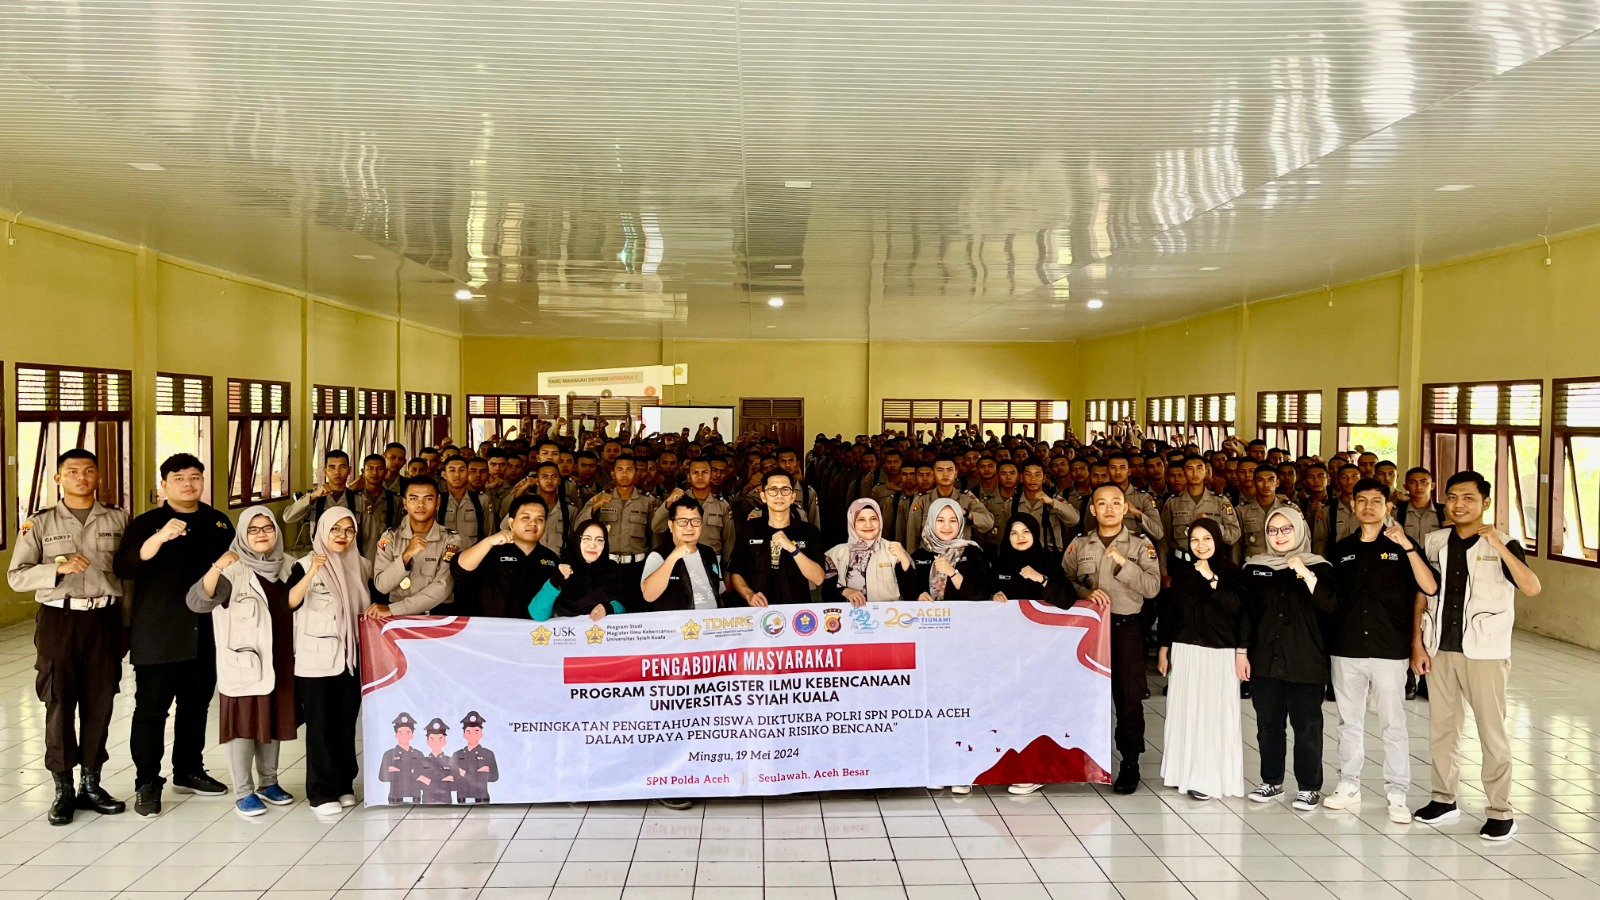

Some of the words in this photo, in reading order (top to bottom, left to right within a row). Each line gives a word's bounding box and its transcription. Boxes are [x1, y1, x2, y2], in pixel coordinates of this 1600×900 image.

[917, 608, 951, 617] ACEH
[703, 616, 753, 630] TDMRC
[553, 627, 576, 637] USK
[642, 653, 737, 677] PENGABDIAN
[744, 648, 843, 671] MASYARAKAT
[570, 686, 645, 699] PROGRAM
[650, 684, 689, 697] STUDI
[694, 680, 765, 694] MAGISTER
[769, 678, 801, 691] ILMU
[806, 675, 910, 689] KEBENCANAAN
[650, 694, 742, 710] UNIVERSITAS
[747, 693, 788, 705] SYIAH
[792, 691, 840, 704] KUALA
[612, 717, 710, 731] PENGETAHUAN
[714, 716, 754, 726] SISWA
[758, 712, 821, 725] DIKTUKBA
[826, 711, 862, 722] POLRI
[865, 710, 888, 720] SPN
[891, 709, 933, 719] POLDA
[937, 708, 970, 718] ACEH
[585, 735, 634, 744] DALAM
[638, 732, 684, 743] UPAYA
[687, 728, 785, 740] PENGURANGAN
[789, 725, 829, 736] RISIKO
[688, 751, 733, 762] Minggu,
[735, 750, 747, 760] 19
[750, 750, 771, 760] Mei
[774, 748, 799, 759] 2024
[646, 777, 668, 786] SPN
[671, 775, 700, 785] Polda
[703, 774, 730, 784] Aceh
[813, 769, 839, 778] Aceh
[842, 768, 870, 776] Besar
